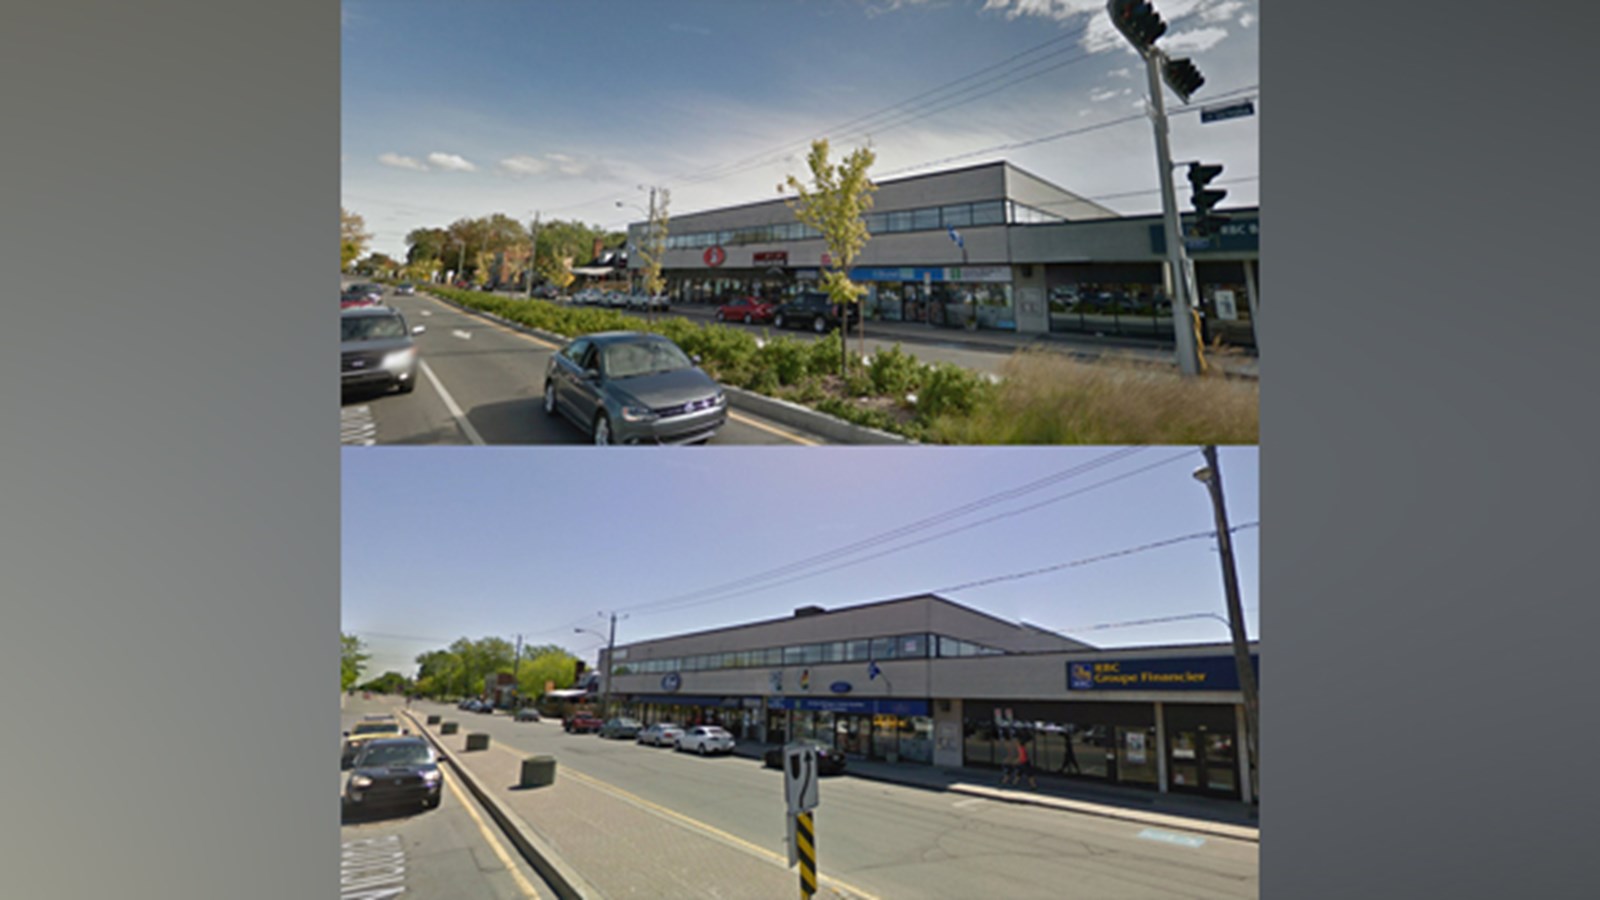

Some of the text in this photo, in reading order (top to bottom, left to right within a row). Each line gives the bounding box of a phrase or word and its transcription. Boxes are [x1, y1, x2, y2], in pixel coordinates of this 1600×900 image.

[1094, 662, 1120, 672] RBC
[1094, 672, 1206, 685] Groupe Financier
